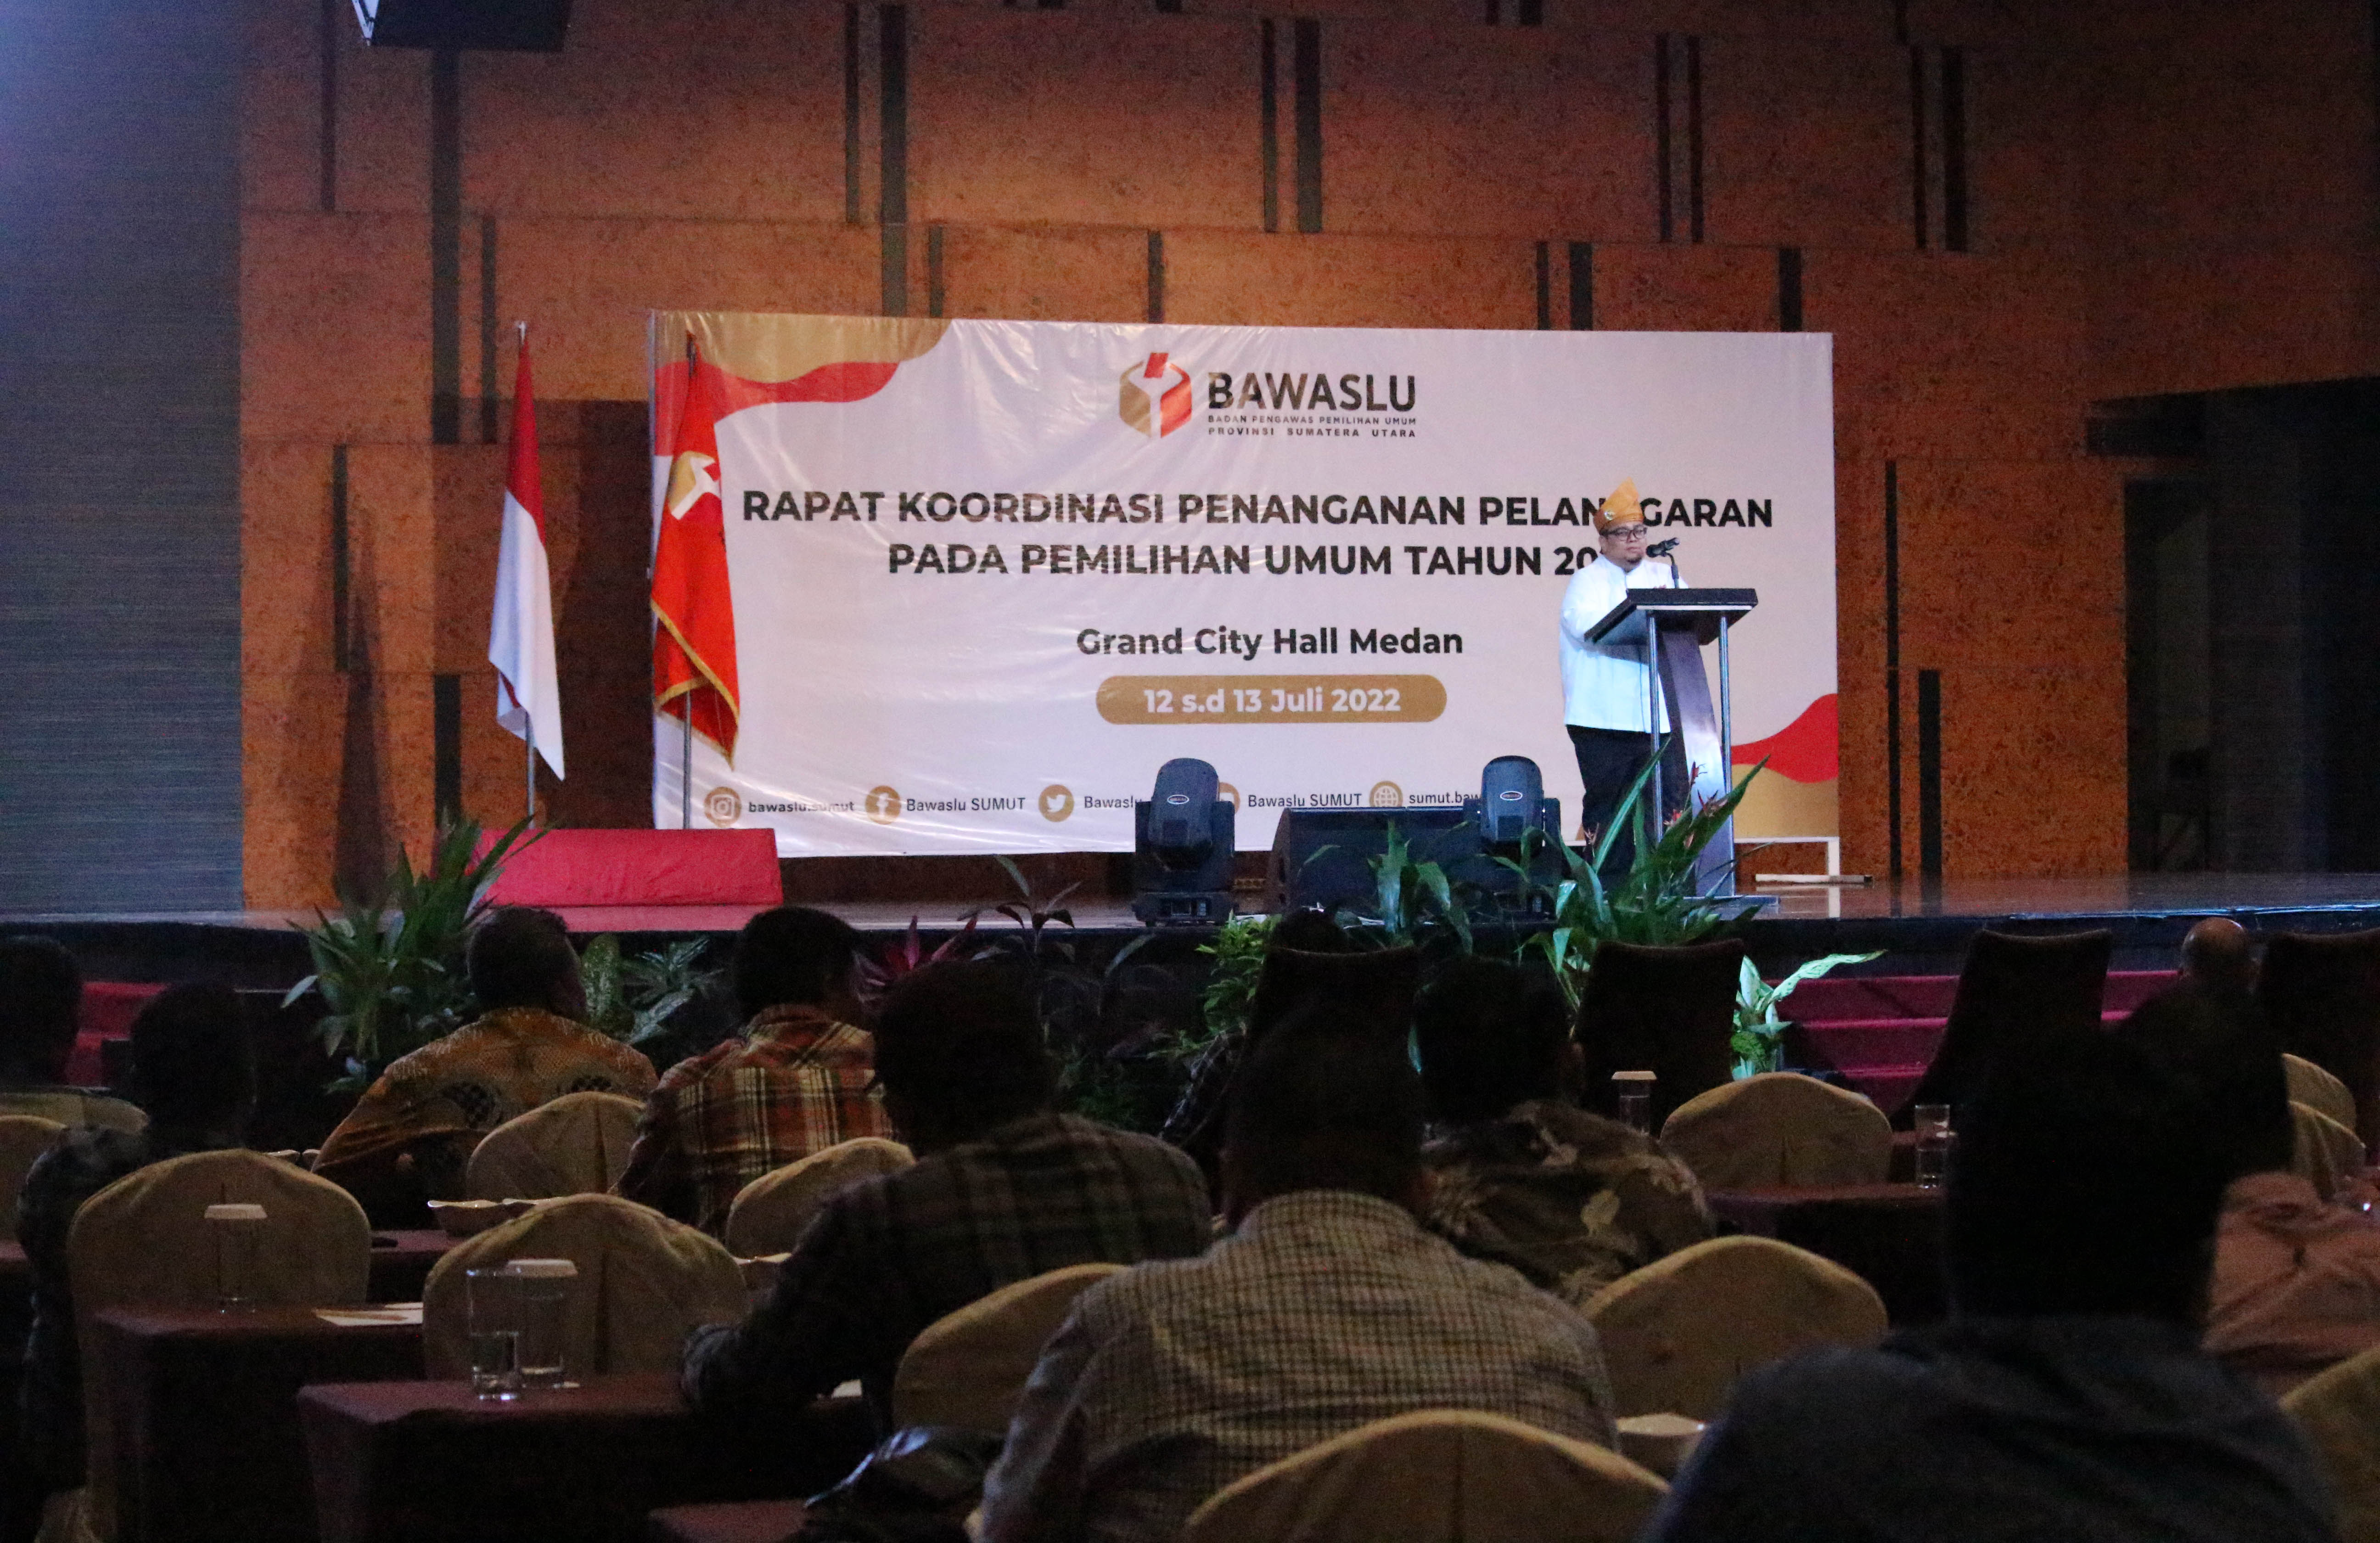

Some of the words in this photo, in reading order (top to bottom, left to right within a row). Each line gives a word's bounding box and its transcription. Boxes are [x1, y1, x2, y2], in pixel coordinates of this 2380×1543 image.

[1208, 372, 1416, 412] BAWASLU
[1208, 427, 1274, 436] PROVINSI
[1287, 428, 1359, 437] SUMATERA
[1372, 429, 1415, 437] UTARA
[1252, 415, 1313, 424] PENGAWAS
[1319, 416, 1379, 424] PEMILIHAN
[1385, 417, 1416, 425] UMUM
[743, 490, 885, 522] RAPAT
[898, 492, 1163, 524] KOORDINASI
[1179, 494, 1465, 525] PENANGANAN
[1479, 496, 1773, 528] PELANGARAN
[889, 543, 1009, 574] PADA
[1022, 544, 1251, 574] PEMILIHAN
[1265, 545, 1392, 575] UMUM
[1404, 546, 1541, 575] TAHUN
[1077, 627, 1183, 655] Grand
[1194, 625, 1263, 661] City
[1274, 627, 1338, 654] Hall
[1350, 627, 1463, 654] Medan
[1144, 689, 1173, 713] 12
[1182, 688, 1225, 713] s.d
[1233, 689, 1262, 713] 13
[1270, 686, 1323, 713] Juli
[1331, 688, 1401, 712] 2022
[906, 798, 966, 811] Bawaslu
[971, 797, 1026, 811] SUMUT
[1248, 794, 1305, 807] Bawaslu
[1310, 793, 1362, 806] SUMUT
